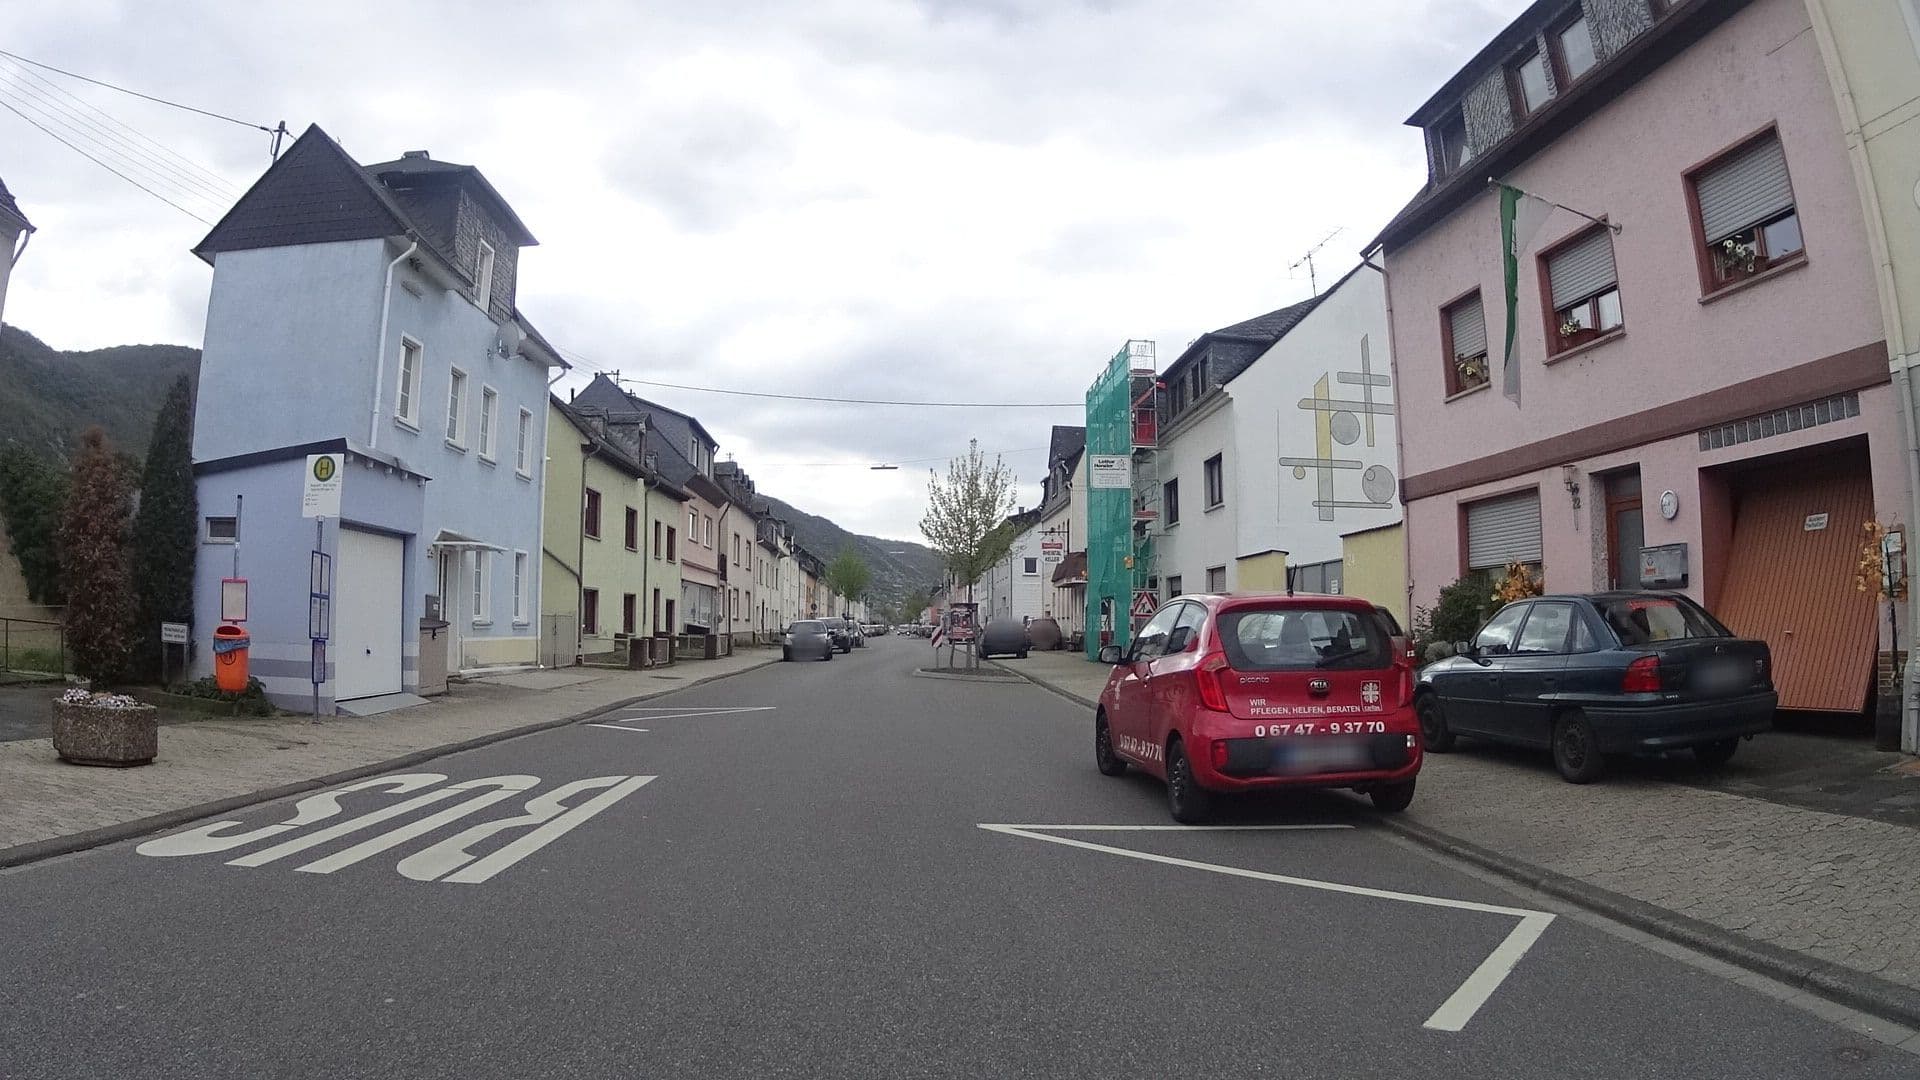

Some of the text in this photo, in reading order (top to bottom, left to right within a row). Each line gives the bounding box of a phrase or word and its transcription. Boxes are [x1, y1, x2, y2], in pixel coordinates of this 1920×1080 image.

[1312, 681, 1328, 689] KIA
[1250, 698, 1266, 706] WIR
[1250, 704, 1361, 715] PFLEGEN, HELFEN, BERATEN
[1255, 725, 1266, 737] 0
[1270, 724, 1291, 737] 67
[1294, 723, 1315, 736] 47
[1330, 722, 1341, 734] 9
[1343, 722, 1363, 734] 37
[1366, 721, 1385, 733] 70
[136, 773, 658, 884] BUS
